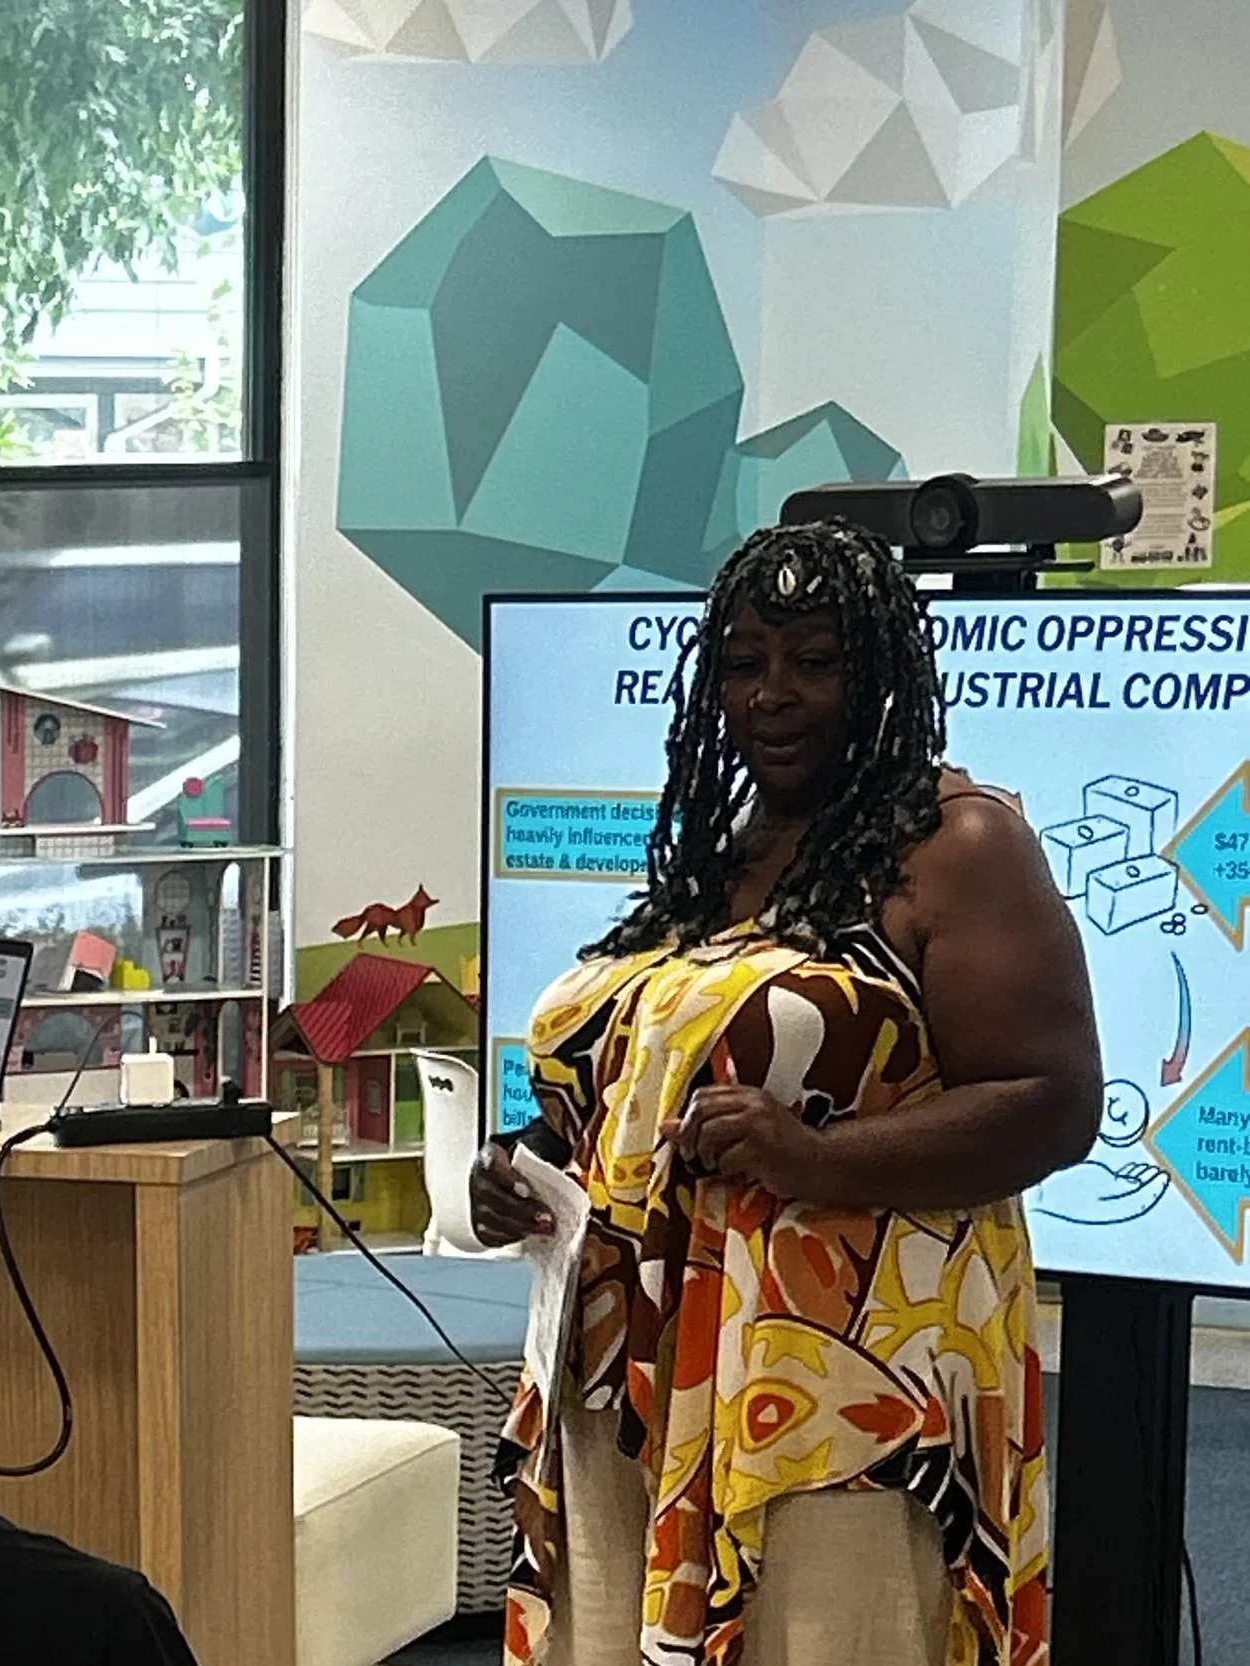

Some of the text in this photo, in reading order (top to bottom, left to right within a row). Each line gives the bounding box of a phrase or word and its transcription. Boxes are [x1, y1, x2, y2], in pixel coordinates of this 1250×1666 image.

[1122, 671, 1250, 710] COMP
[506, 800, 661, 821] Government decis
[506, 825, 562, 848] heavily
[506, 853, 555, 870] estate
[559, 853, 571, 870] &
[1199, 1105, 1250, 1132] Many
